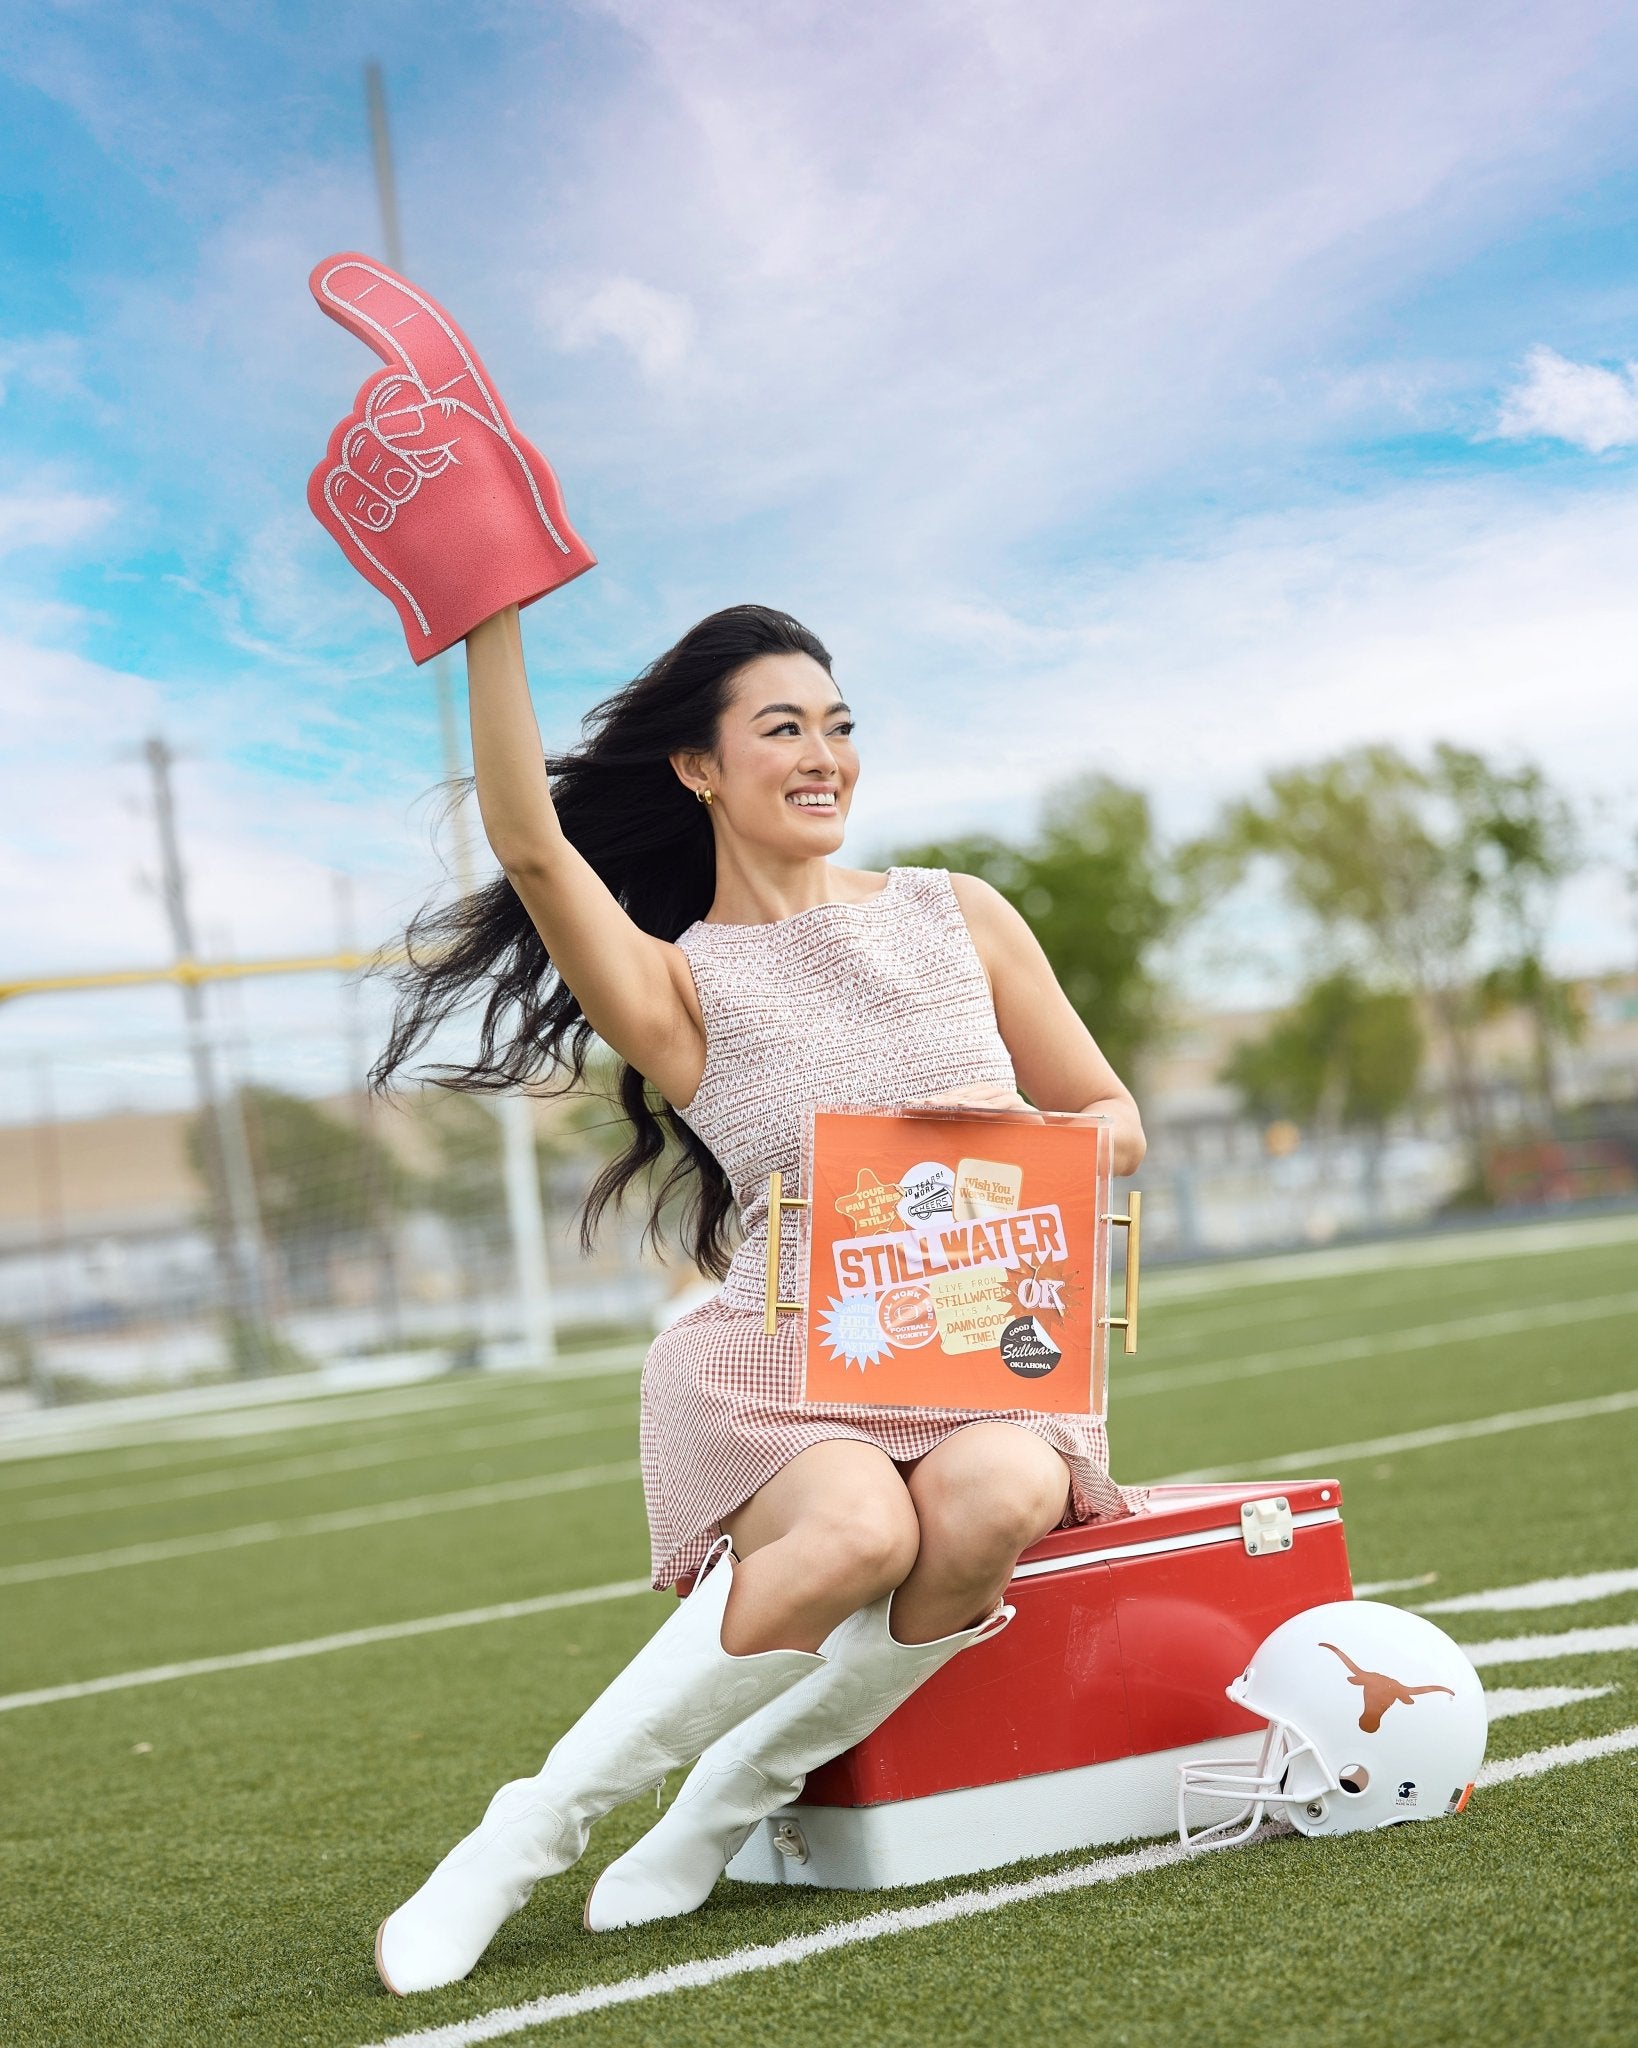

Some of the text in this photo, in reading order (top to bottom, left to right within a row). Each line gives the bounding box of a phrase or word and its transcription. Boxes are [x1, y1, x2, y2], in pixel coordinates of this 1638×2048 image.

[915, 1170, 944, 1191] TEARS!
[964, 1177, 1011, 1195] Wish You
[856, 1187, 885, 1201] YOUR
[914, 1184, 935, 1200] MORE
[960, 1187, 985, 1200] Wee
[986, 1191, 1015, 1206] Here!
[845, 1200, 865, 1213] FAV
[869, 1206, 881, 1217] IN
[914, 1196, 949, 1213] CHEERS
[859, 1210, 895, 1228] STILLY
[839, 1212, 1061, 1289] STILLWATER
[938, 1276, 997, 1293] LIVE FROM
[891, 1290, 922, 1301] WORK
[935, 1286, 1007, 1309] STILLWATER
[1017, 1278, 1066, 1309] OK
[985, 1304, 992, 1312] A
[890, 1323, 932, 1333] FOOTBALL
[946, 1313, 1007, 1334] DAMN GOOD
[1009, 1324, 1030, 1336] GOOD
[963, 1330, 997, 1344] TIME!
[1009, 1361, 1052, 1370] OKLAHOMA
